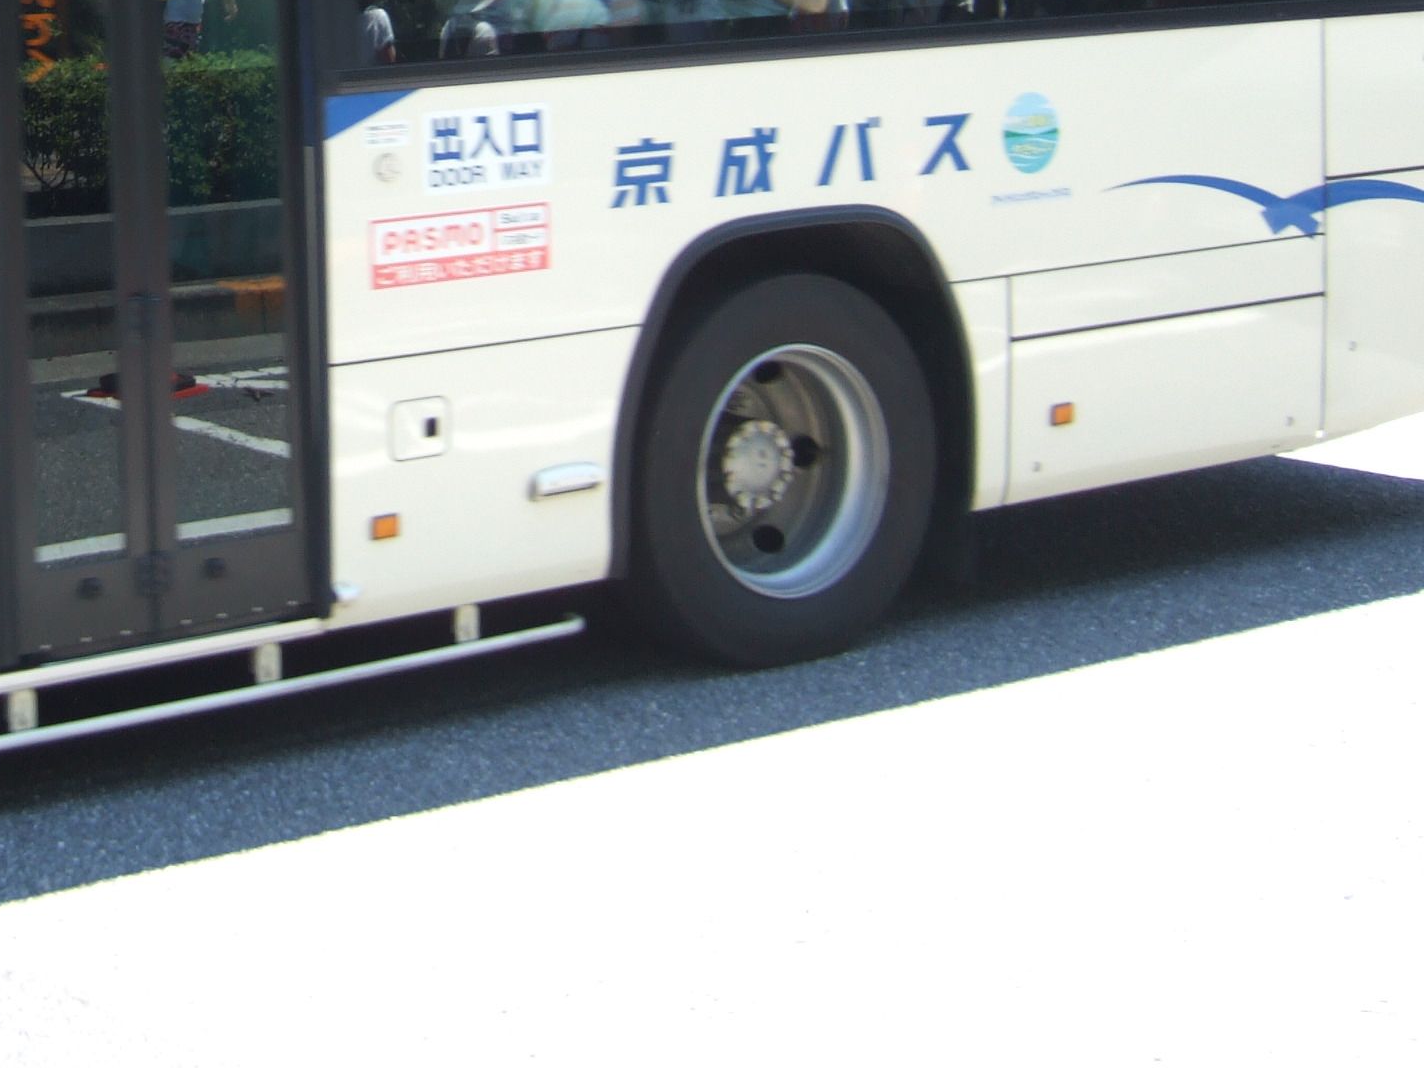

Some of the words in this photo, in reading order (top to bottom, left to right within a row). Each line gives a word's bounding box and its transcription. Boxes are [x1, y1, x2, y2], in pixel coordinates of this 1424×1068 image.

[430, 109, 544, 164] 出入口
[428, 164, 487, 188] DOOR
[500, 160, 545, 181] WAY
[608, 112, 974, 209] 京成バス
[381, 222, 485, 255] PASMO
